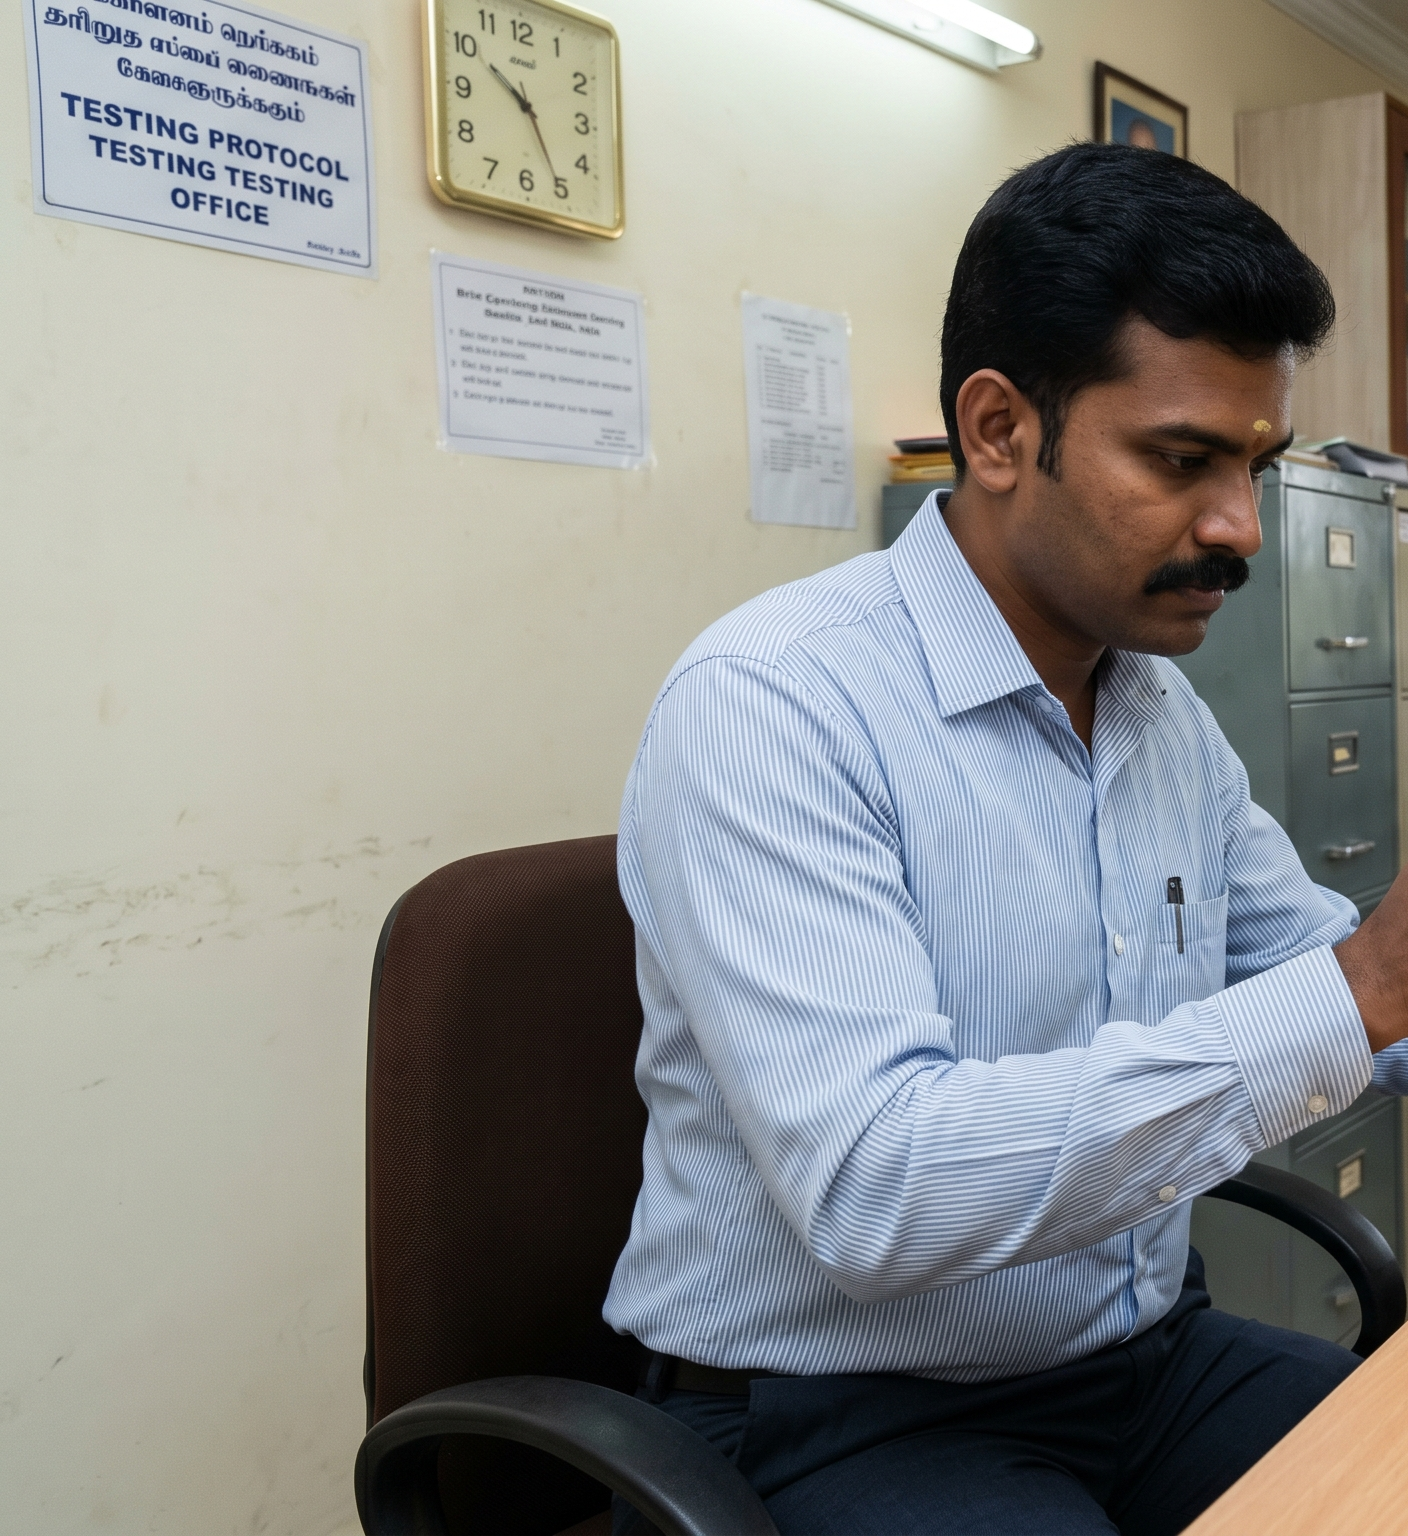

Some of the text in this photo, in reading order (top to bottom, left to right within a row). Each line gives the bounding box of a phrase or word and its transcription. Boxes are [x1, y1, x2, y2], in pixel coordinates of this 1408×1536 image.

[479, 10, 494, 34] 11
[511, 20, 533, 46] 12
[454, 32, 476, 57] 10
[553, 37, 561, 58] 1
[456, 76, 471, 98] 9
[573, 72, 586, 95] 2
[458, 120, 474, 143] 8
[575, 113, 589, 135] 3
[60, 91, 349, 182] TESTING PROTOCOL
[88, 134, 334, 209] TESTING TESTING
[484, 158, 498, 179] 7
[575, 155, 589, 174] 4
[520, 170, 533, 191] 6
[554, 176, 568, 198] 5
[170, 187, 270, 226] OFFICE
